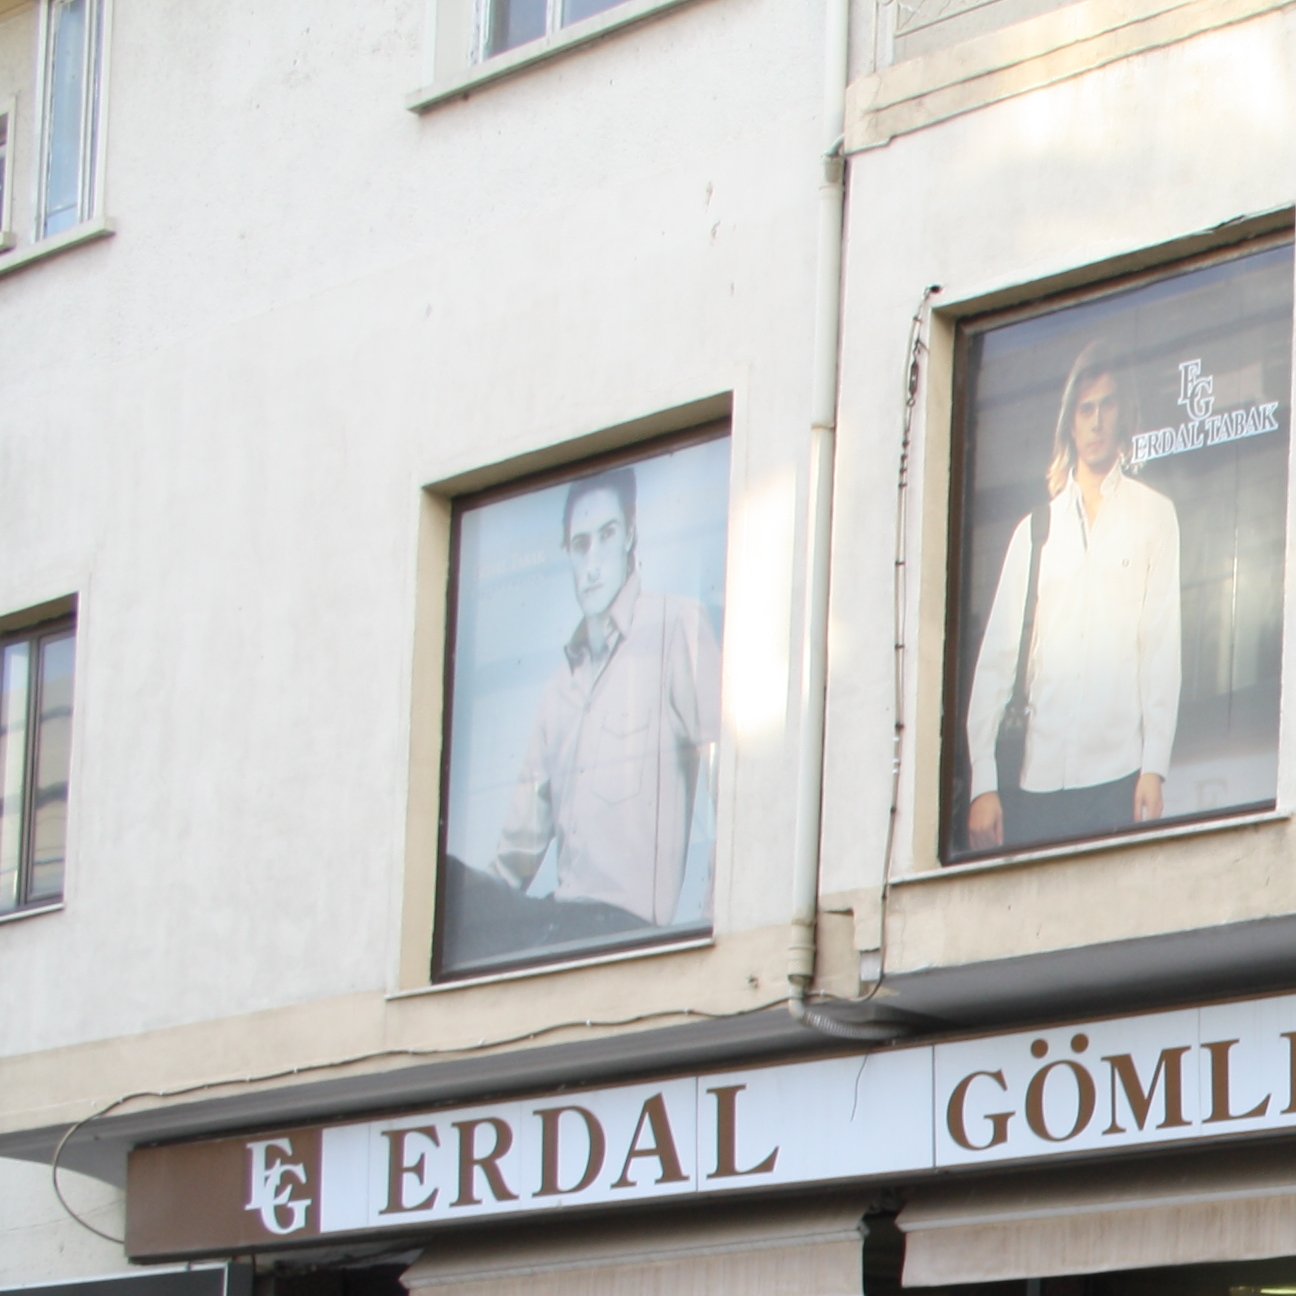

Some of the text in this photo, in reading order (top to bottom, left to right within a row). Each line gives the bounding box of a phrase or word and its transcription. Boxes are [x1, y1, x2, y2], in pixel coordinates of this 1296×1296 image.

[1131, 402, 1278, 464] ERDAL TABAK
[378, 1083, 781, 1217] ERDAL
